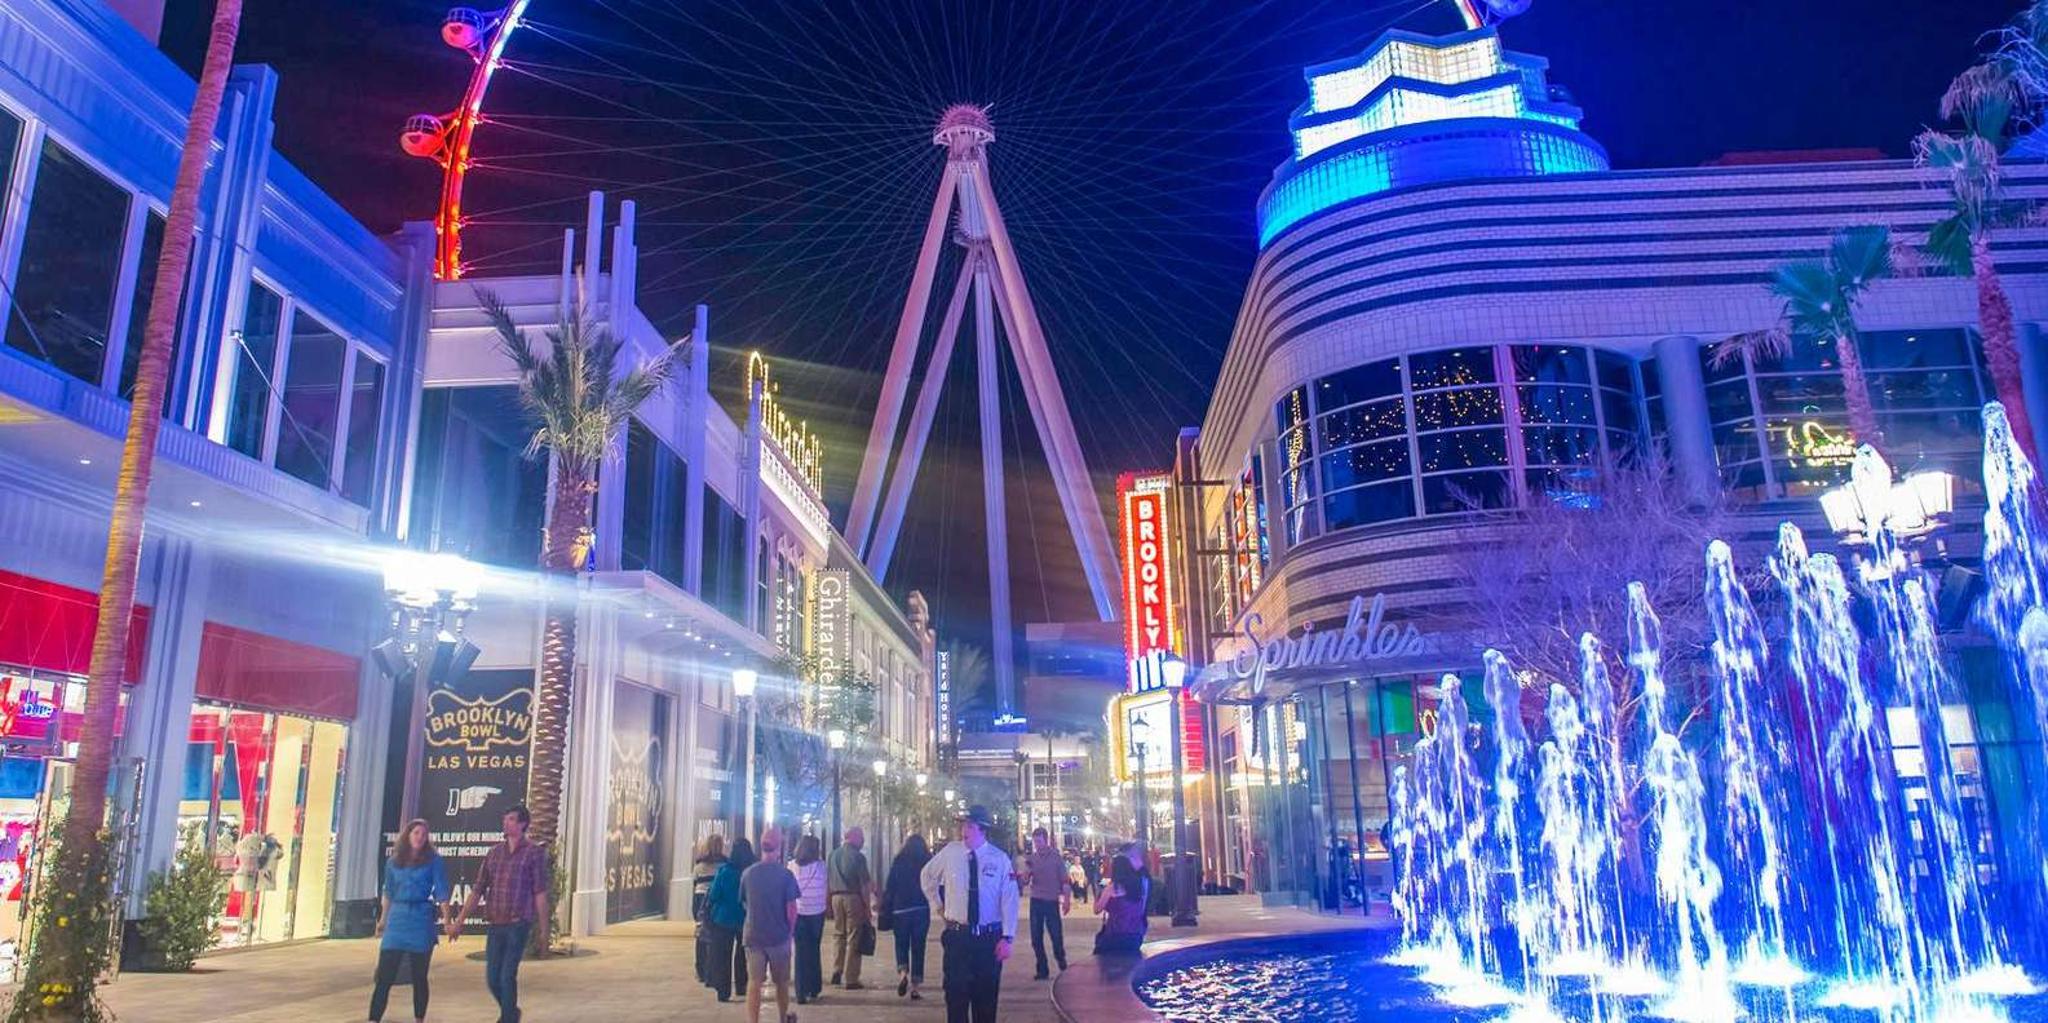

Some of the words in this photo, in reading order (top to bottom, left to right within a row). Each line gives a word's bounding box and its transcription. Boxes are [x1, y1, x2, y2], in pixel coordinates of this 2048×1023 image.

[1234, 592, 1425, 694] Sprinkles
[940, 651, 949, 690] Yard
[430, 707, 528, 733] BROOKLYN
[460, 724, 501, 737] BOWL
[428, 756, 461, 769] LAS
[467, 755, 525, 769] VEGAS
[467, 832, 480, 842] OUR
[458, 847, 491, 857] INCREDI
